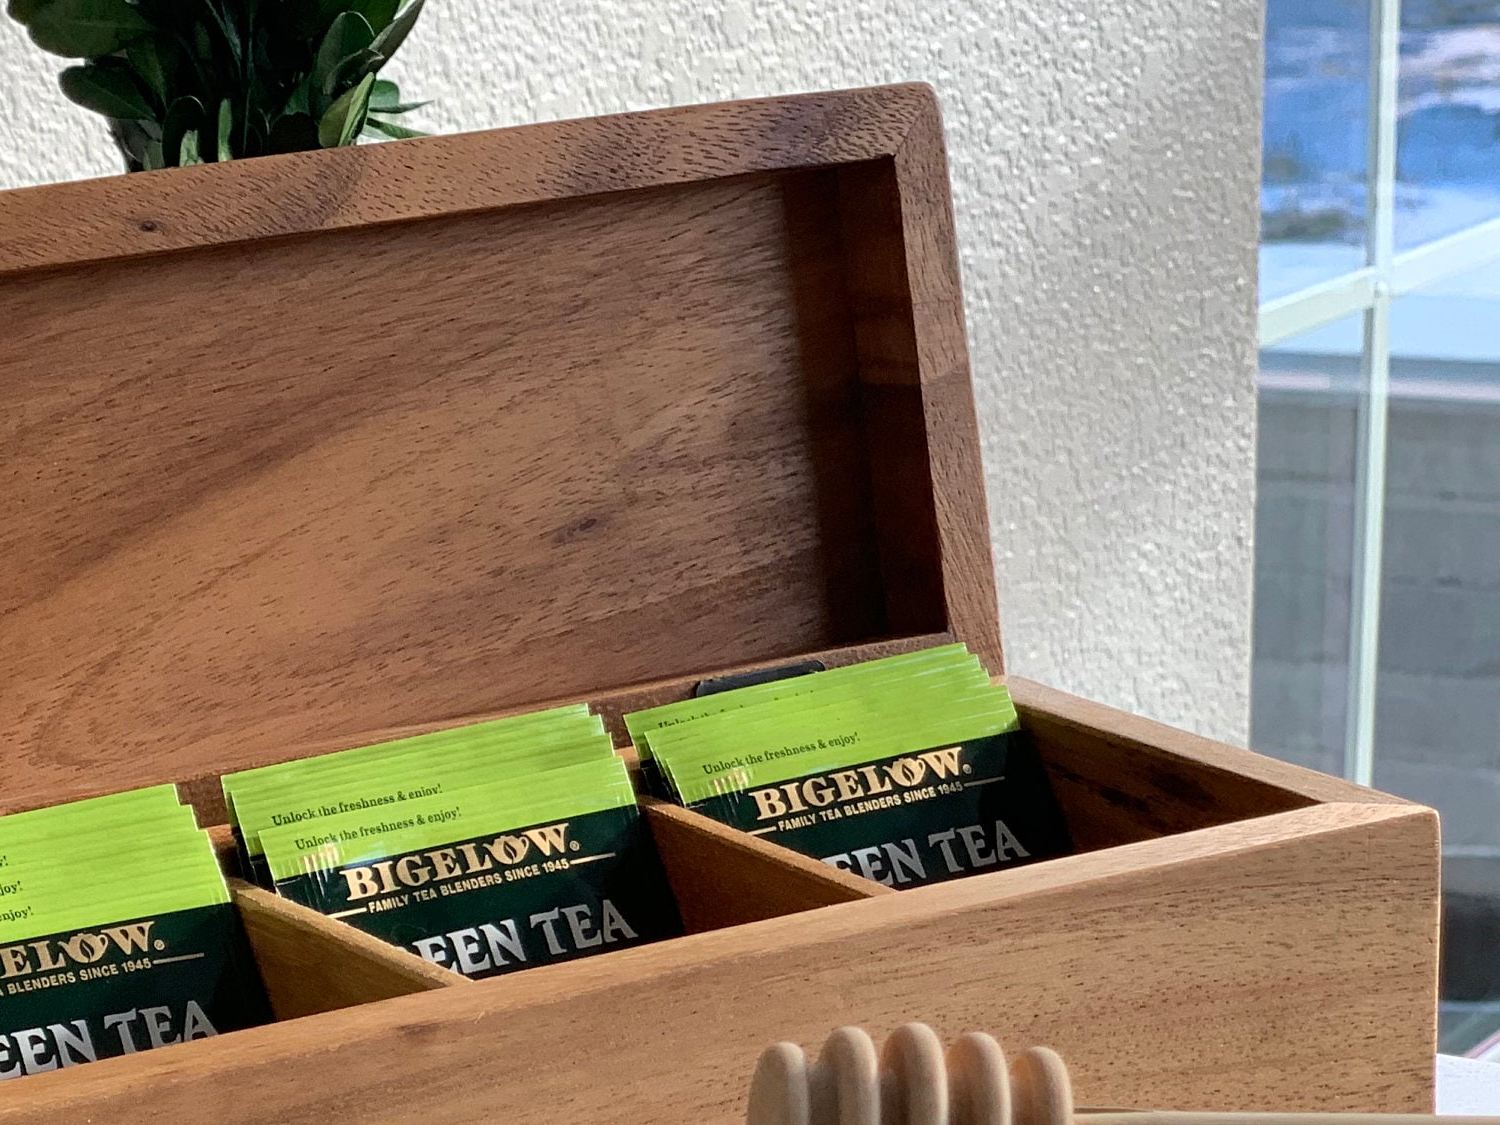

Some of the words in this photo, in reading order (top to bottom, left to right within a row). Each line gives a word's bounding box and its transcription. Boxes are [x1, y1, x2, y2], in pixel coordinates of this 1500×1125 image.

[702, 757, 744, 775] Unlock
[745, 754, 763, 766] the
[764, 743, 817, 762] freshness
[817, 739, 827, 749] &
[828, 731, 861, 750] enjoy!
[271, 809, 316, 827] Unlock
[318, 804, 338, 818] the
[339, 792, 395, 813] freshness
[396, 790, 407, 801] &
[408, 783, 444, 798] enjoy!
[749, 747, 963, 820] BIGELOW
[778, 813, 817, 832] FAMILY
[820, 808, 842, 821] TEA
[844, 794, 901, 817] BLENDERS
[903, 786, 936, 803] SINCE
[937, 781, 963, 795] 1945
[295, 832, 339, 850] Unlock
[340, 828, 358, 842] the
[359, 817, 415, 837] freshness
[416, 814, 426, 825] &
[427, 806, 462, 827] enjoy!
[928, 820, 1031, 873] TEA
[339, 822, 570, 901] BIGELOW
[369, 894, 409, 914] FAMILY
[413, 888, 437, 902] TEA
[441, 873, 502, 896] BLENDERS
[505, 864, 541, 881] SINCE
[542, 858, 570, 874] 1945
[413, 919, 527, 975] EEN
[530, 899, 639, 957] TEA
[7, 971, 76, 995] BLENDERS
[80, 963, 118, 981] SINCE
[121, 957, 151, 973] 1945
[104, 1000, 219, 1054] TEA
